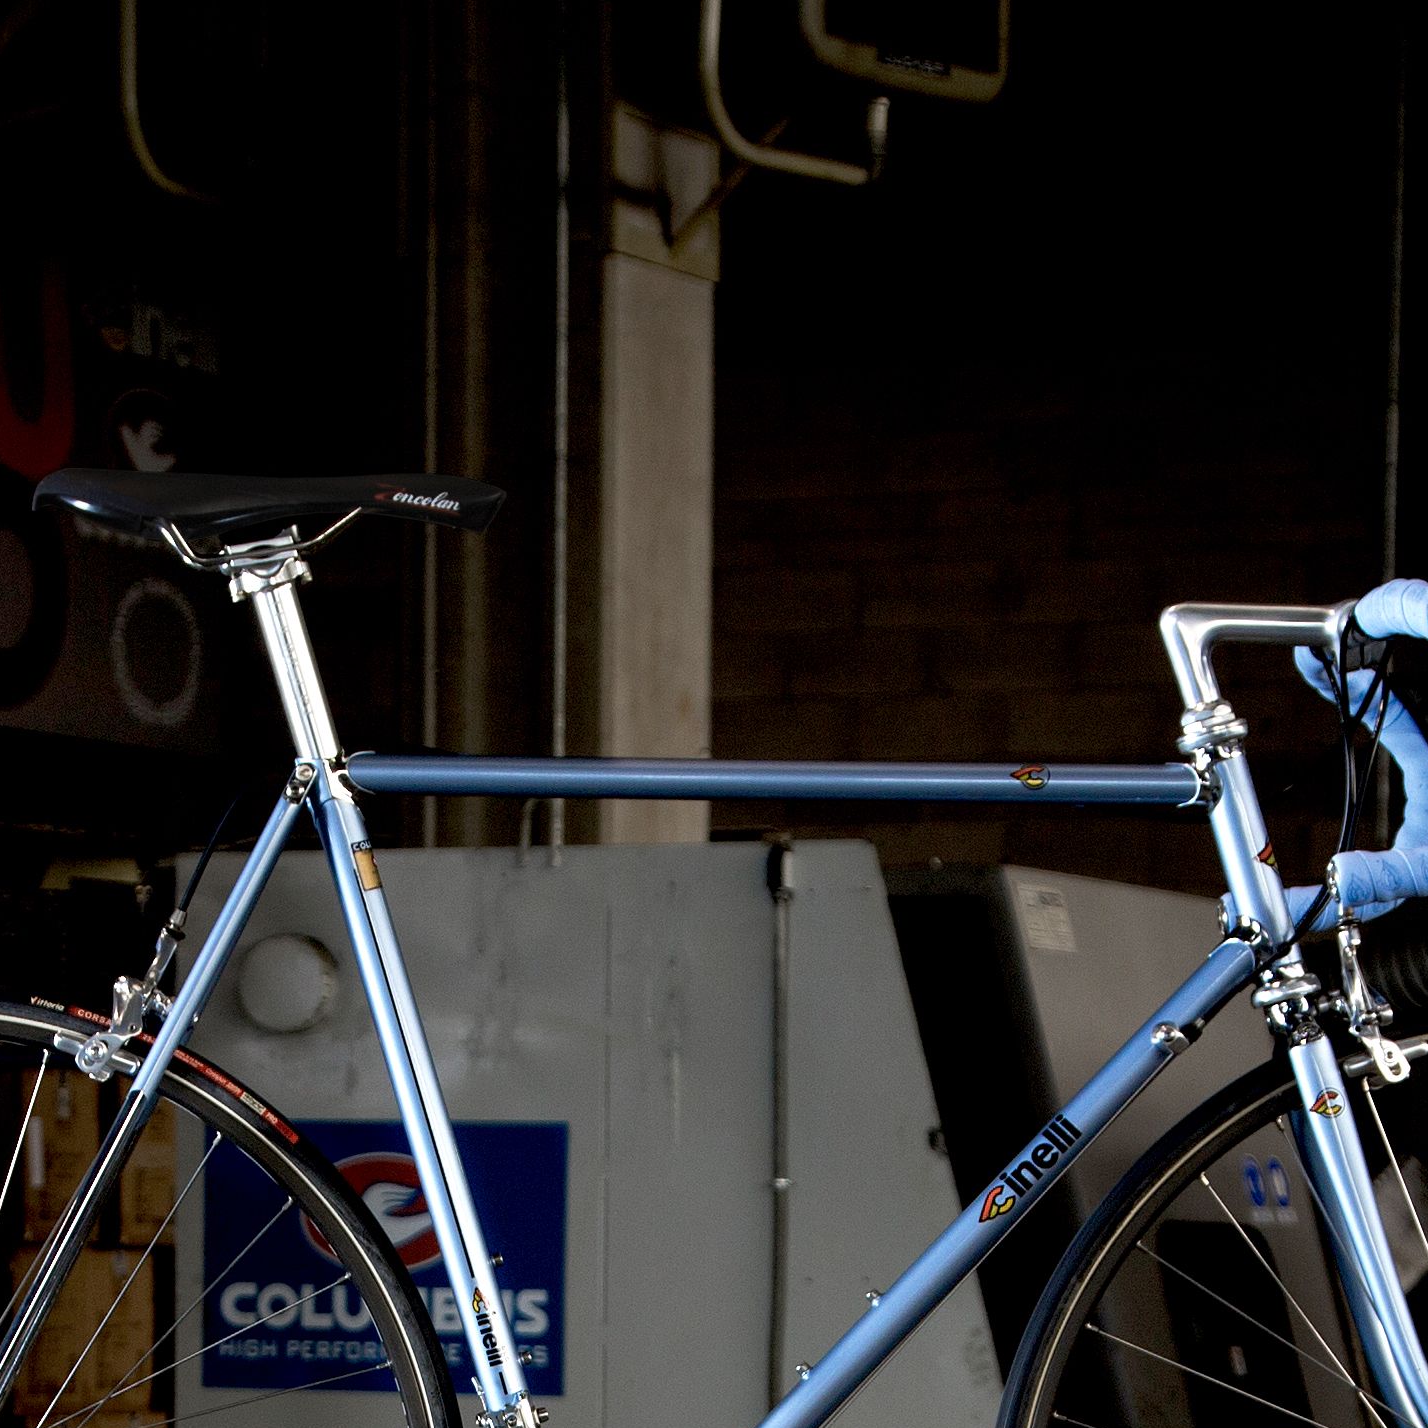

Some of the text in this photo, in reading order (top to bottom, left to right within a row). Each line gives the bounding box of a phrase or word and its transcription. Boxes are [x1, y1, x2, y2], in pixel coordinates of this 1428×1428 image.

[30, 996, 65, 1011] Vittoria
[979, 1114, 1082, 1223] Cinelli
[219, 1281, 550, 1337] COLUBS
[219, 1337, 278, 1359] HIGH
